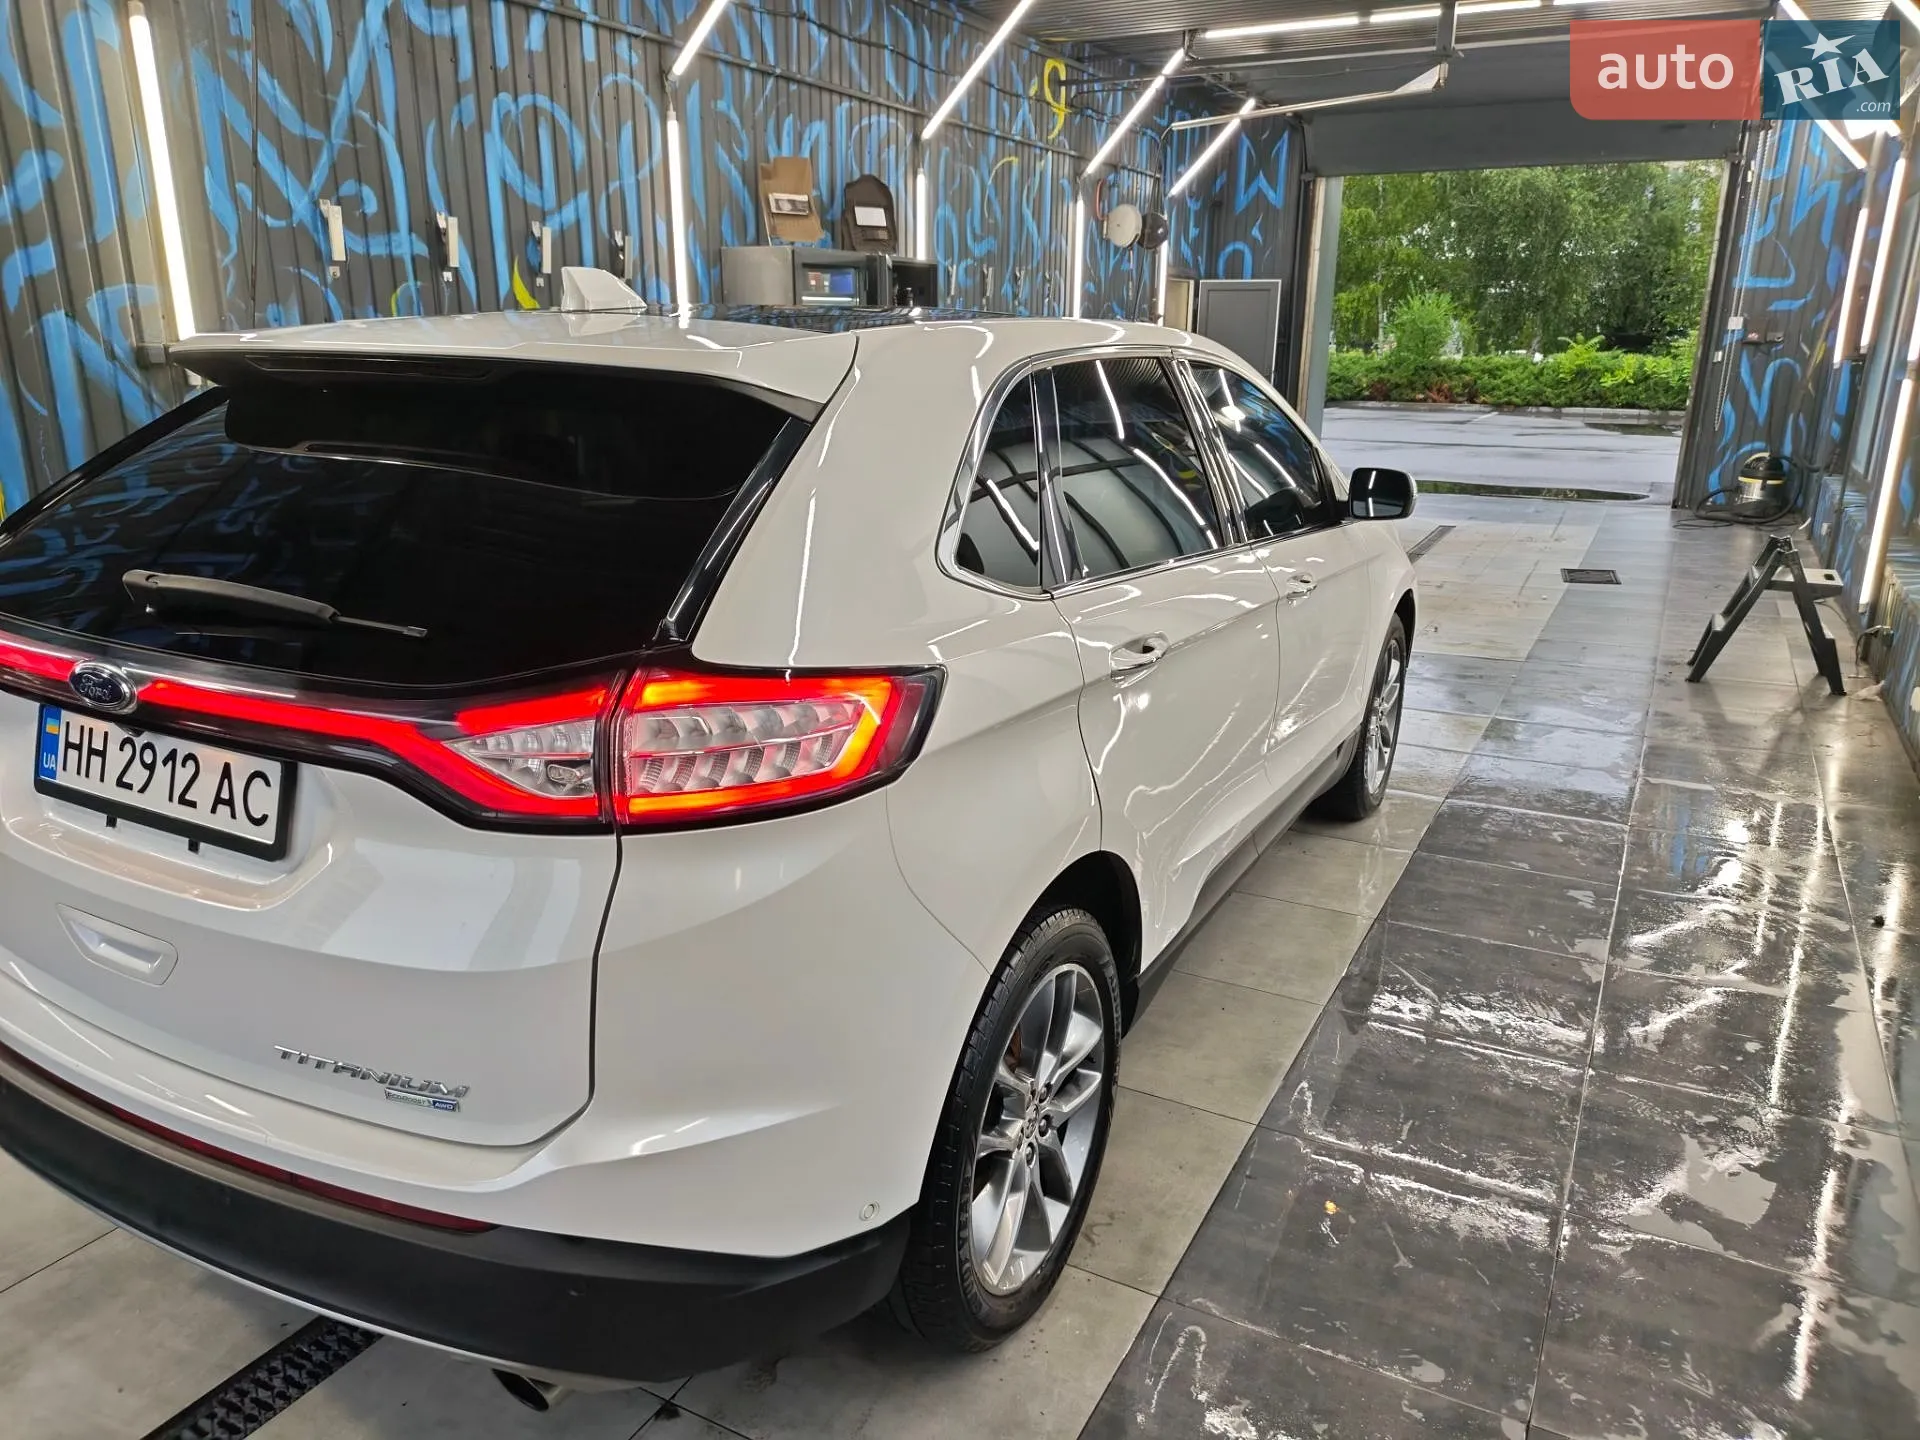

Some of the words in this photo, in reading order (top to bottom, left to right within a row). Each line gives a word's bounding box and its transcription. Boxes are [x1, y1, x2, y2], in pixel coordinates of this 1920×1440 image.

[43, 752, 57, 771] UA
[62, 720, 109, 784] HH
[115, 736, 201, 809] 2912
[210, 761, 272, 828] AC
[273, 1044, 471, 1098] TITANIUM
